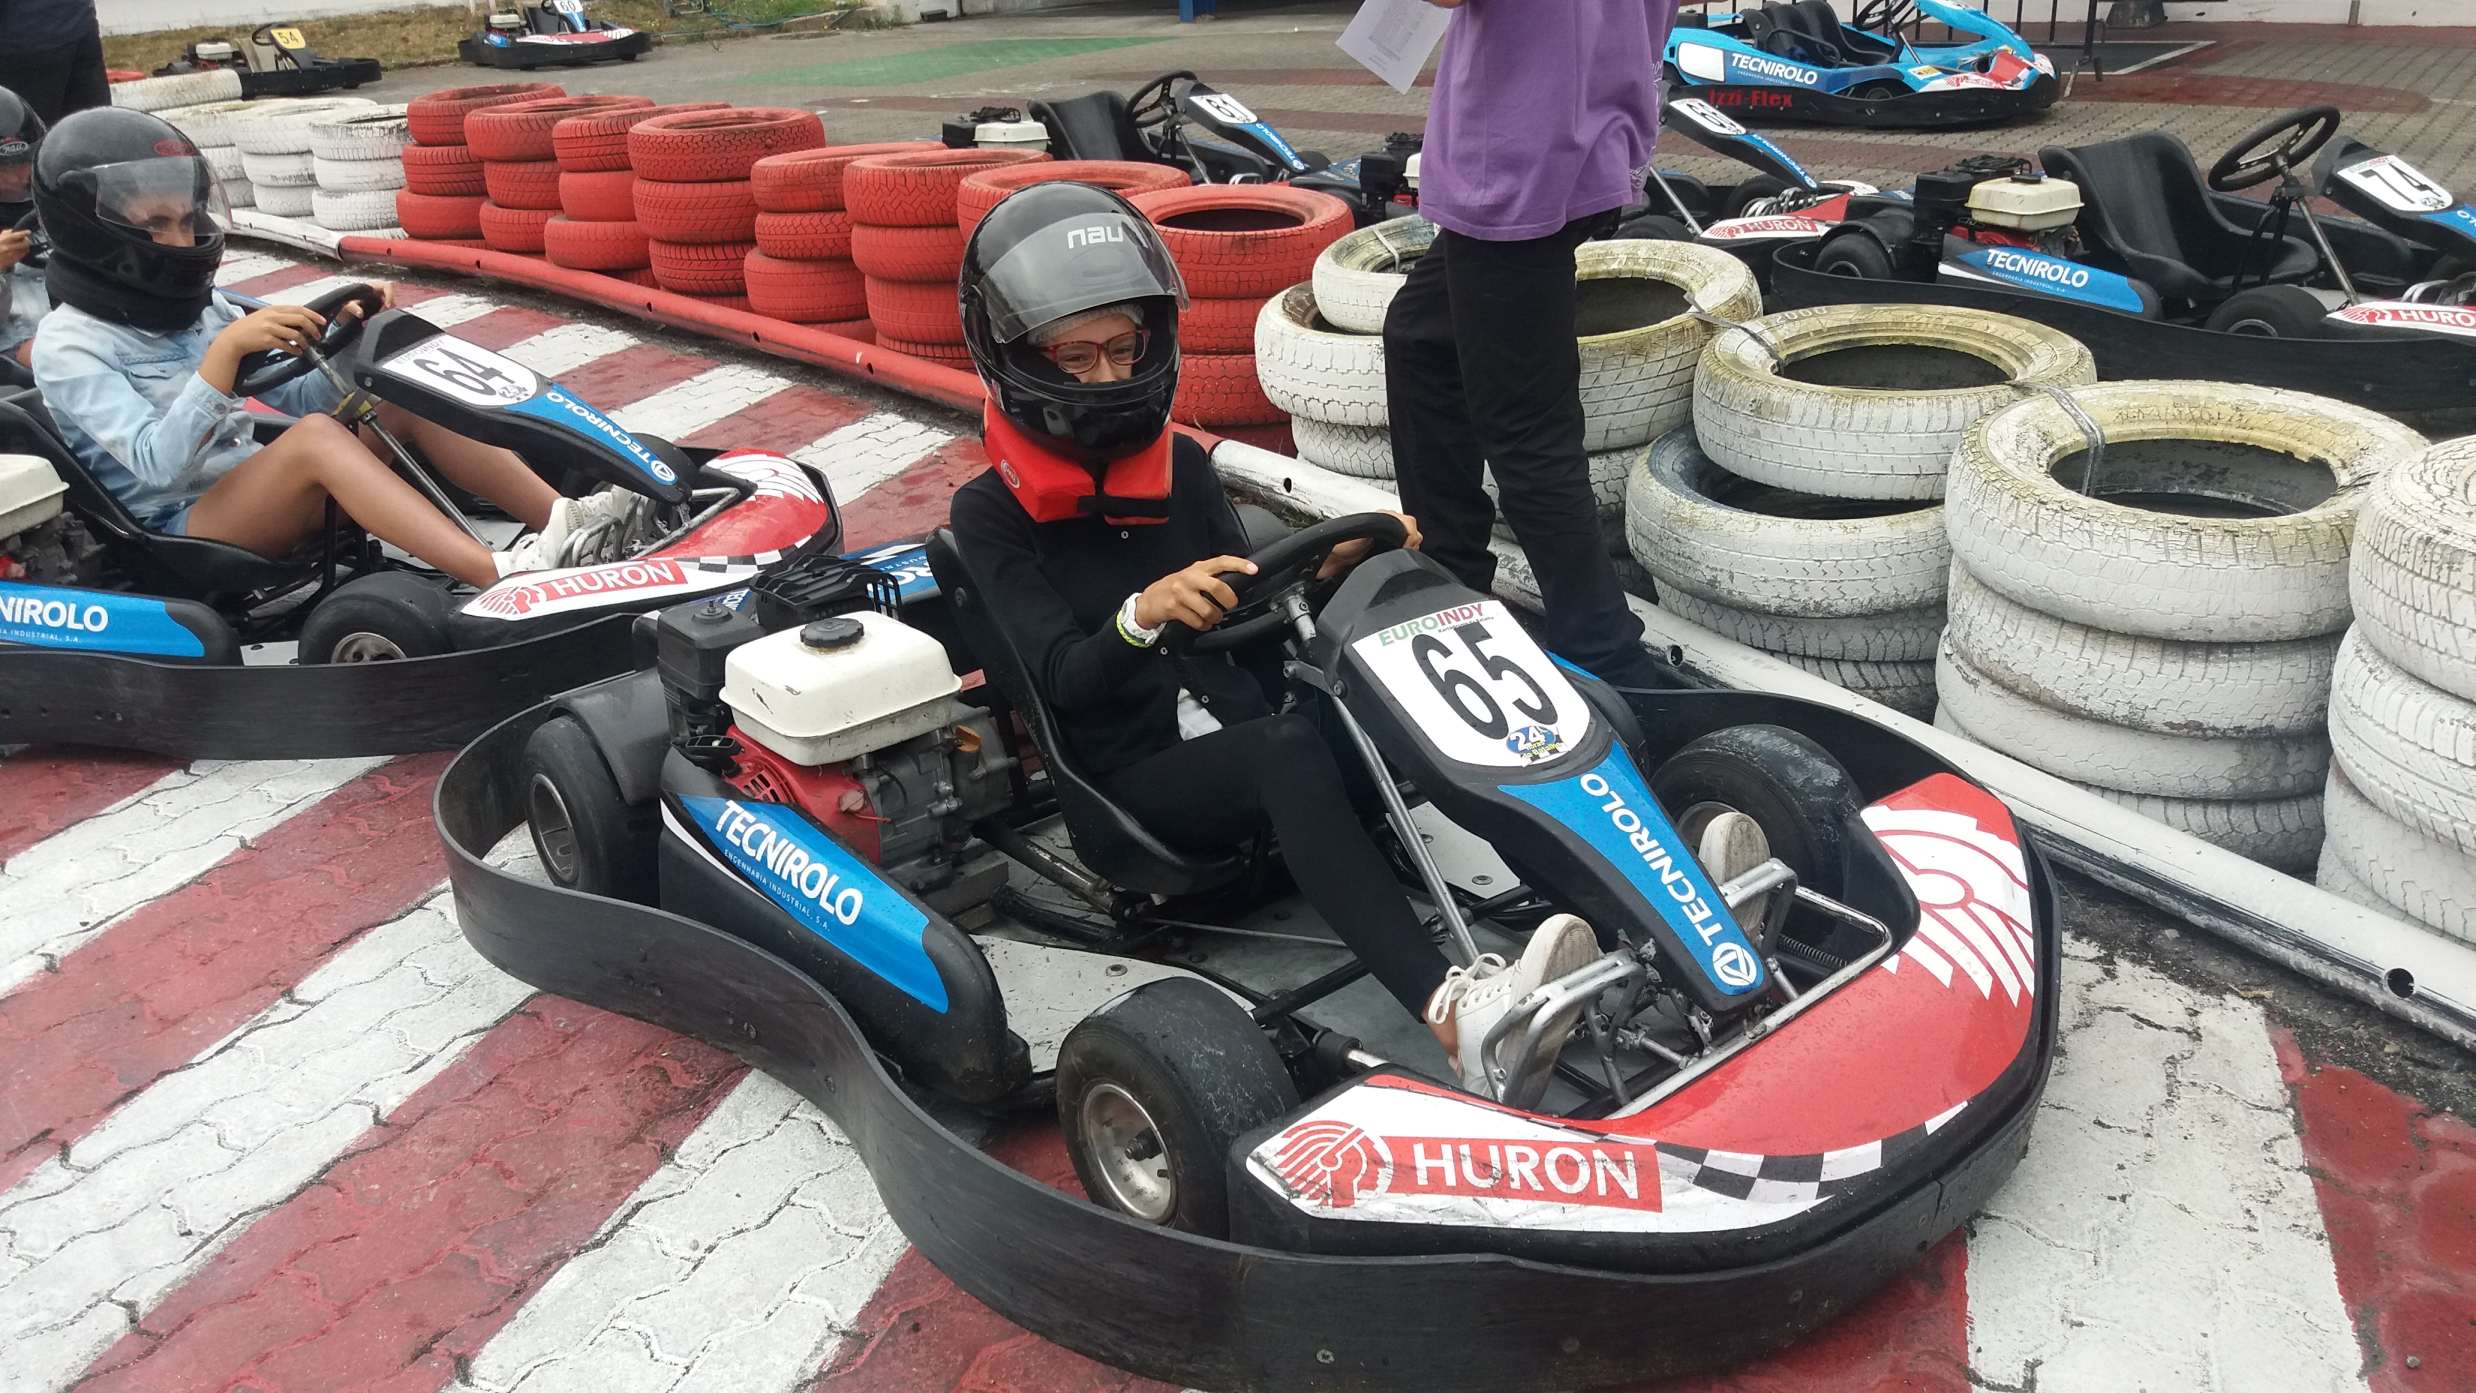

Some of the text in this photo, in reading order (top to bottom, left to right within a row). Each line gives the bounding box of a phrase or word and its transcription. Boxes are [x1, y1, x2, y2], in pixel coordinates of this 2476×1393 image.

[277, 31, 299, 46] 54
[1731, 53, 1818, 85] TECNIROLO
[2358, 163, 2442, 204] 74
[1067, 226, 1123, 249] nau
[1745, 219, 1813, 232] HURON
[1986, 248, 2089, 288] TECNIROLO
[413, 347, 516, 396] 64
[546, 391, 651, 464] TECNIROLO
[548, 560, 675, 597] HURON
[1378, 603, 1484, 647] EUROINDY
[1411, 621, 1558, 740] 65
[715, 800, 863, 925] TECNIROLO
[724, 849, 768, 886] ENGENHARIA
[1580, 773, 1723, 946] TECNIROLO
[1412, 1142, 1639, 1200] HURON
